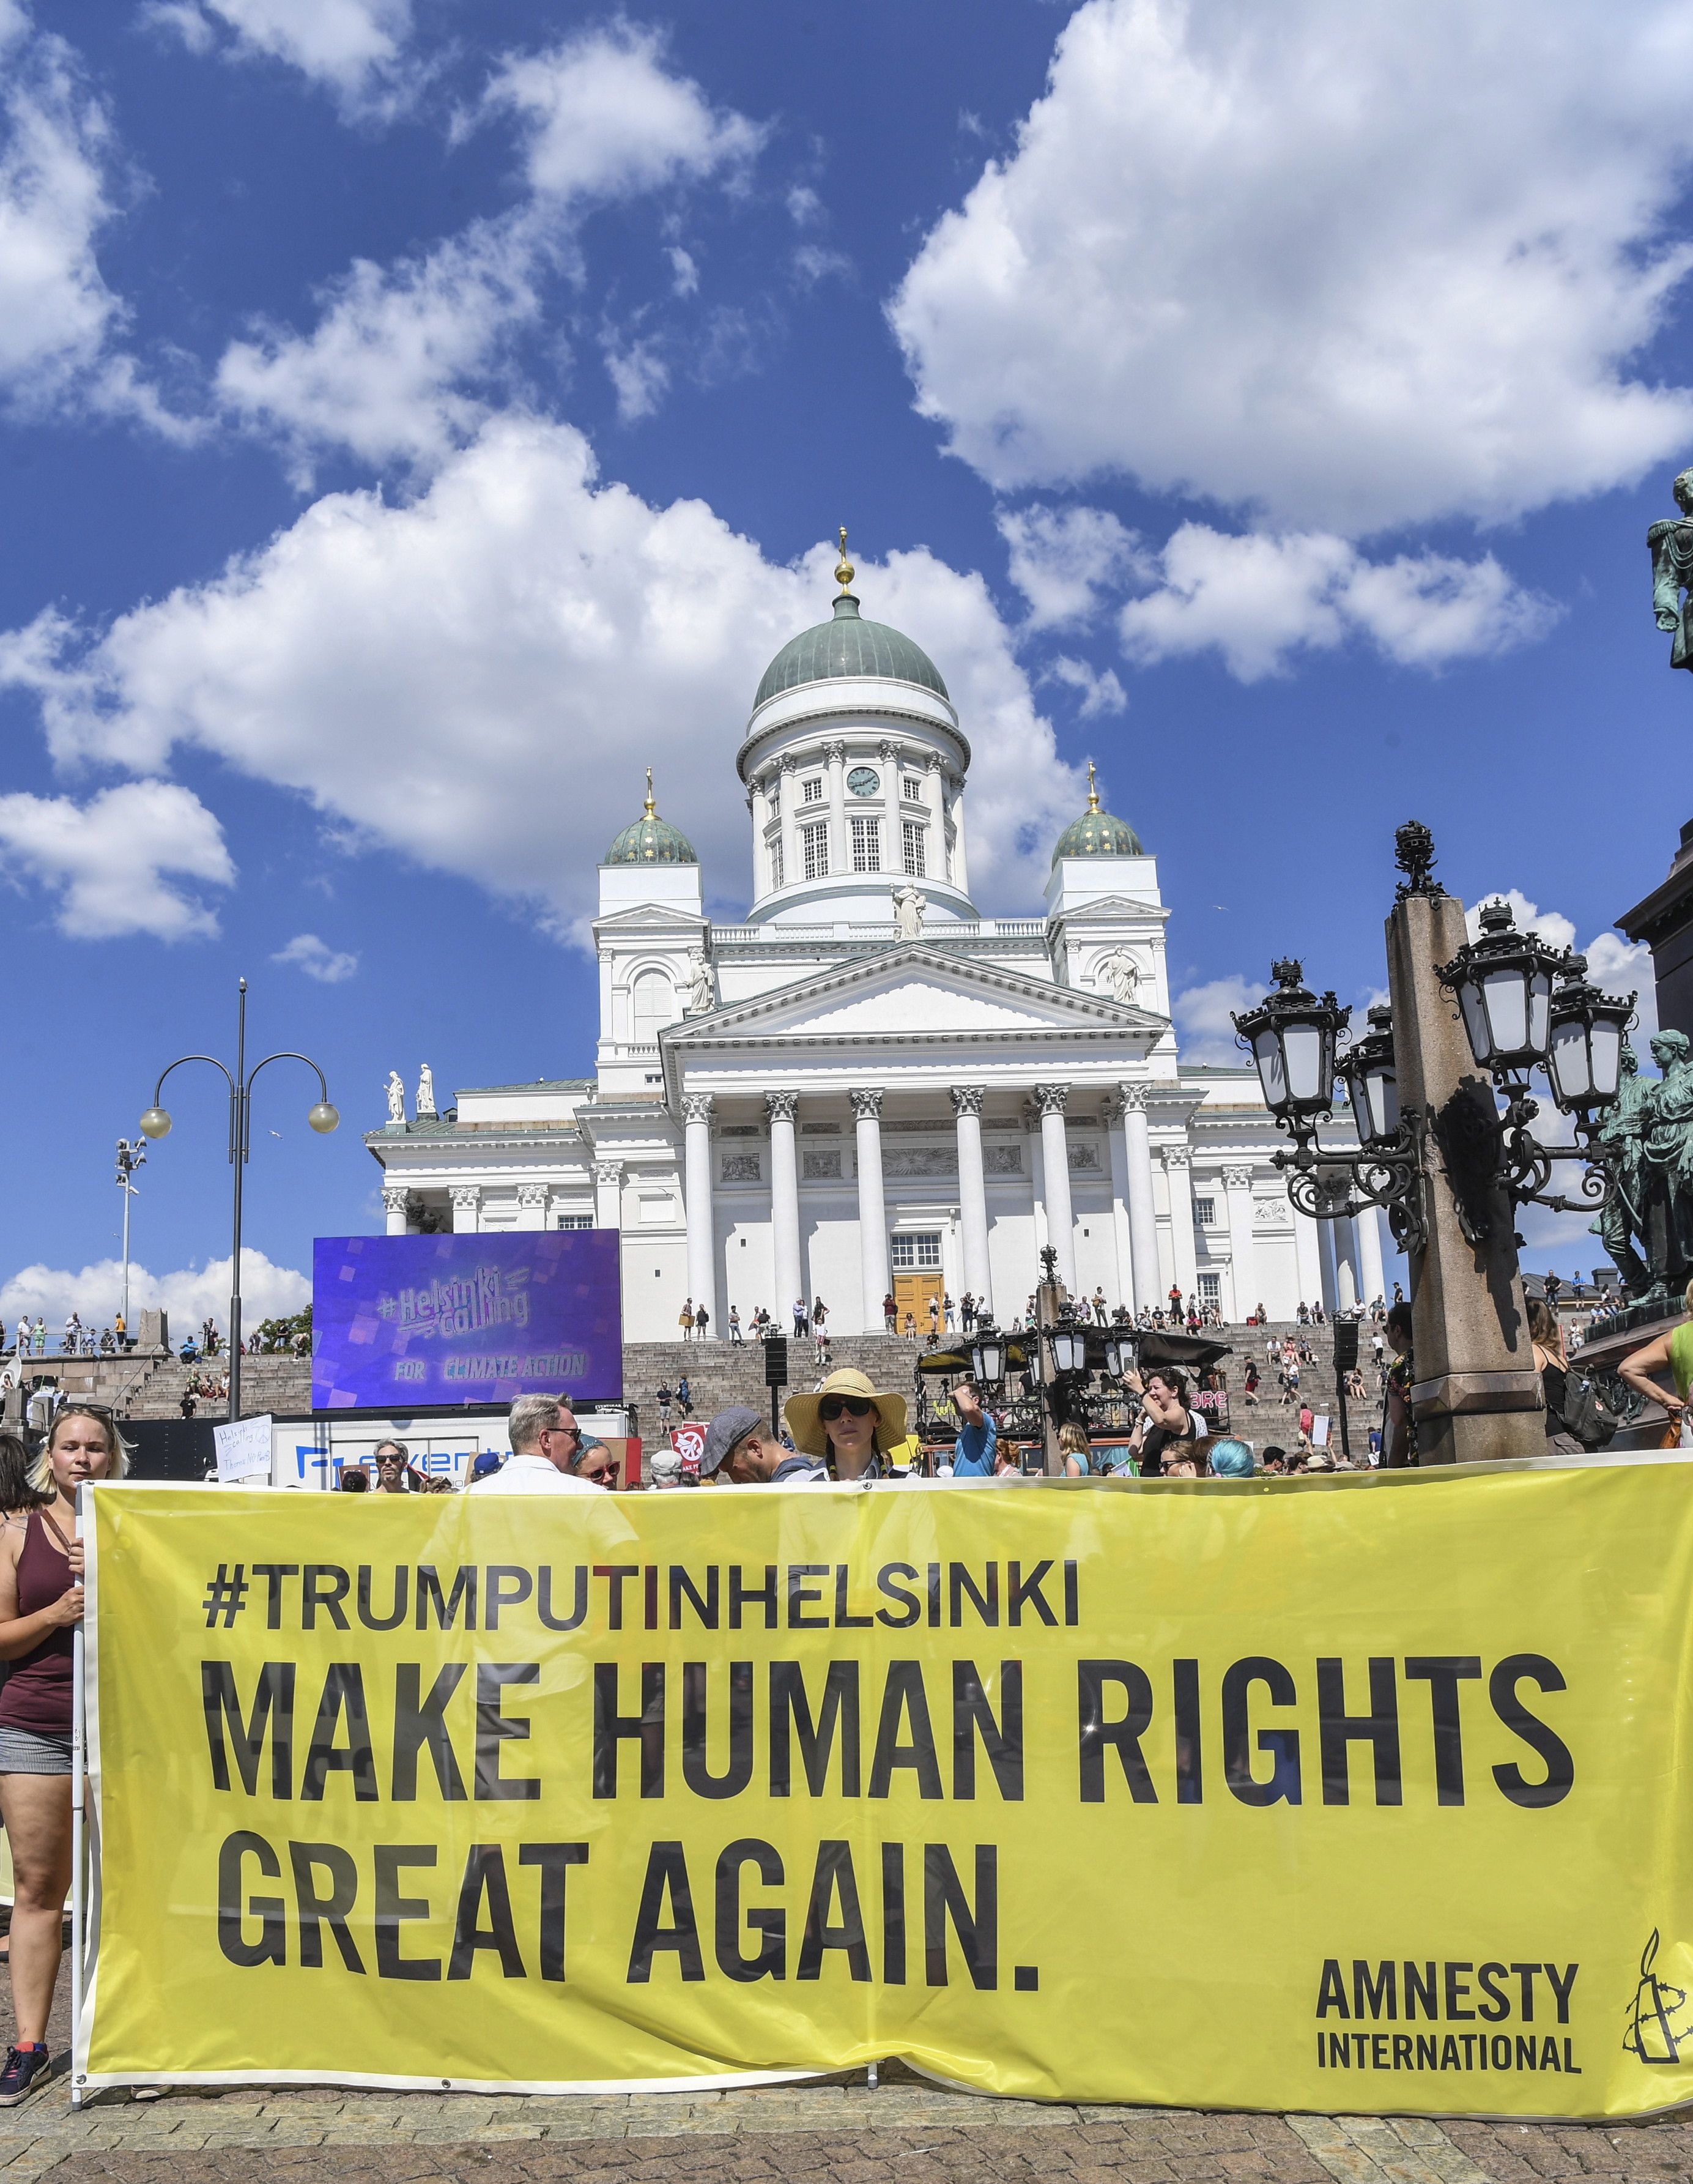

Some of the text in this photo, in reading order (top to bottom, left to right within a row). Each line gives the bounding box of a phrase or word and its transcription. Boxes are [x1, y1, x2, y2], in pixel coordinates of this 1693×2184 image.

[377, 1265, 500, 1321] #Helsinki
[439, 1291, 528, 1338] calling
[395, 1353, 586, 1381] FOR CLIMATE ACTION
[220, 1424, 247, 1444] Helsinki
[232, 1435, 253, 1447] calling
[202, 1559, 1078, 1632] #TRUMPUTINHELSINKI
[202, 1660, 541, 1802] MAKE
[592, 1660, 1024, 1802] HUMAN
[1078, 1653, 1574, 1808] RIGHTS
[217, 1830, 1039, 1991] GREAT AGAIN.
[1316, 1959, 1579, 2024] AMNESTY
[1317, 2032, 1582, 2074] INTERNATIONAL
